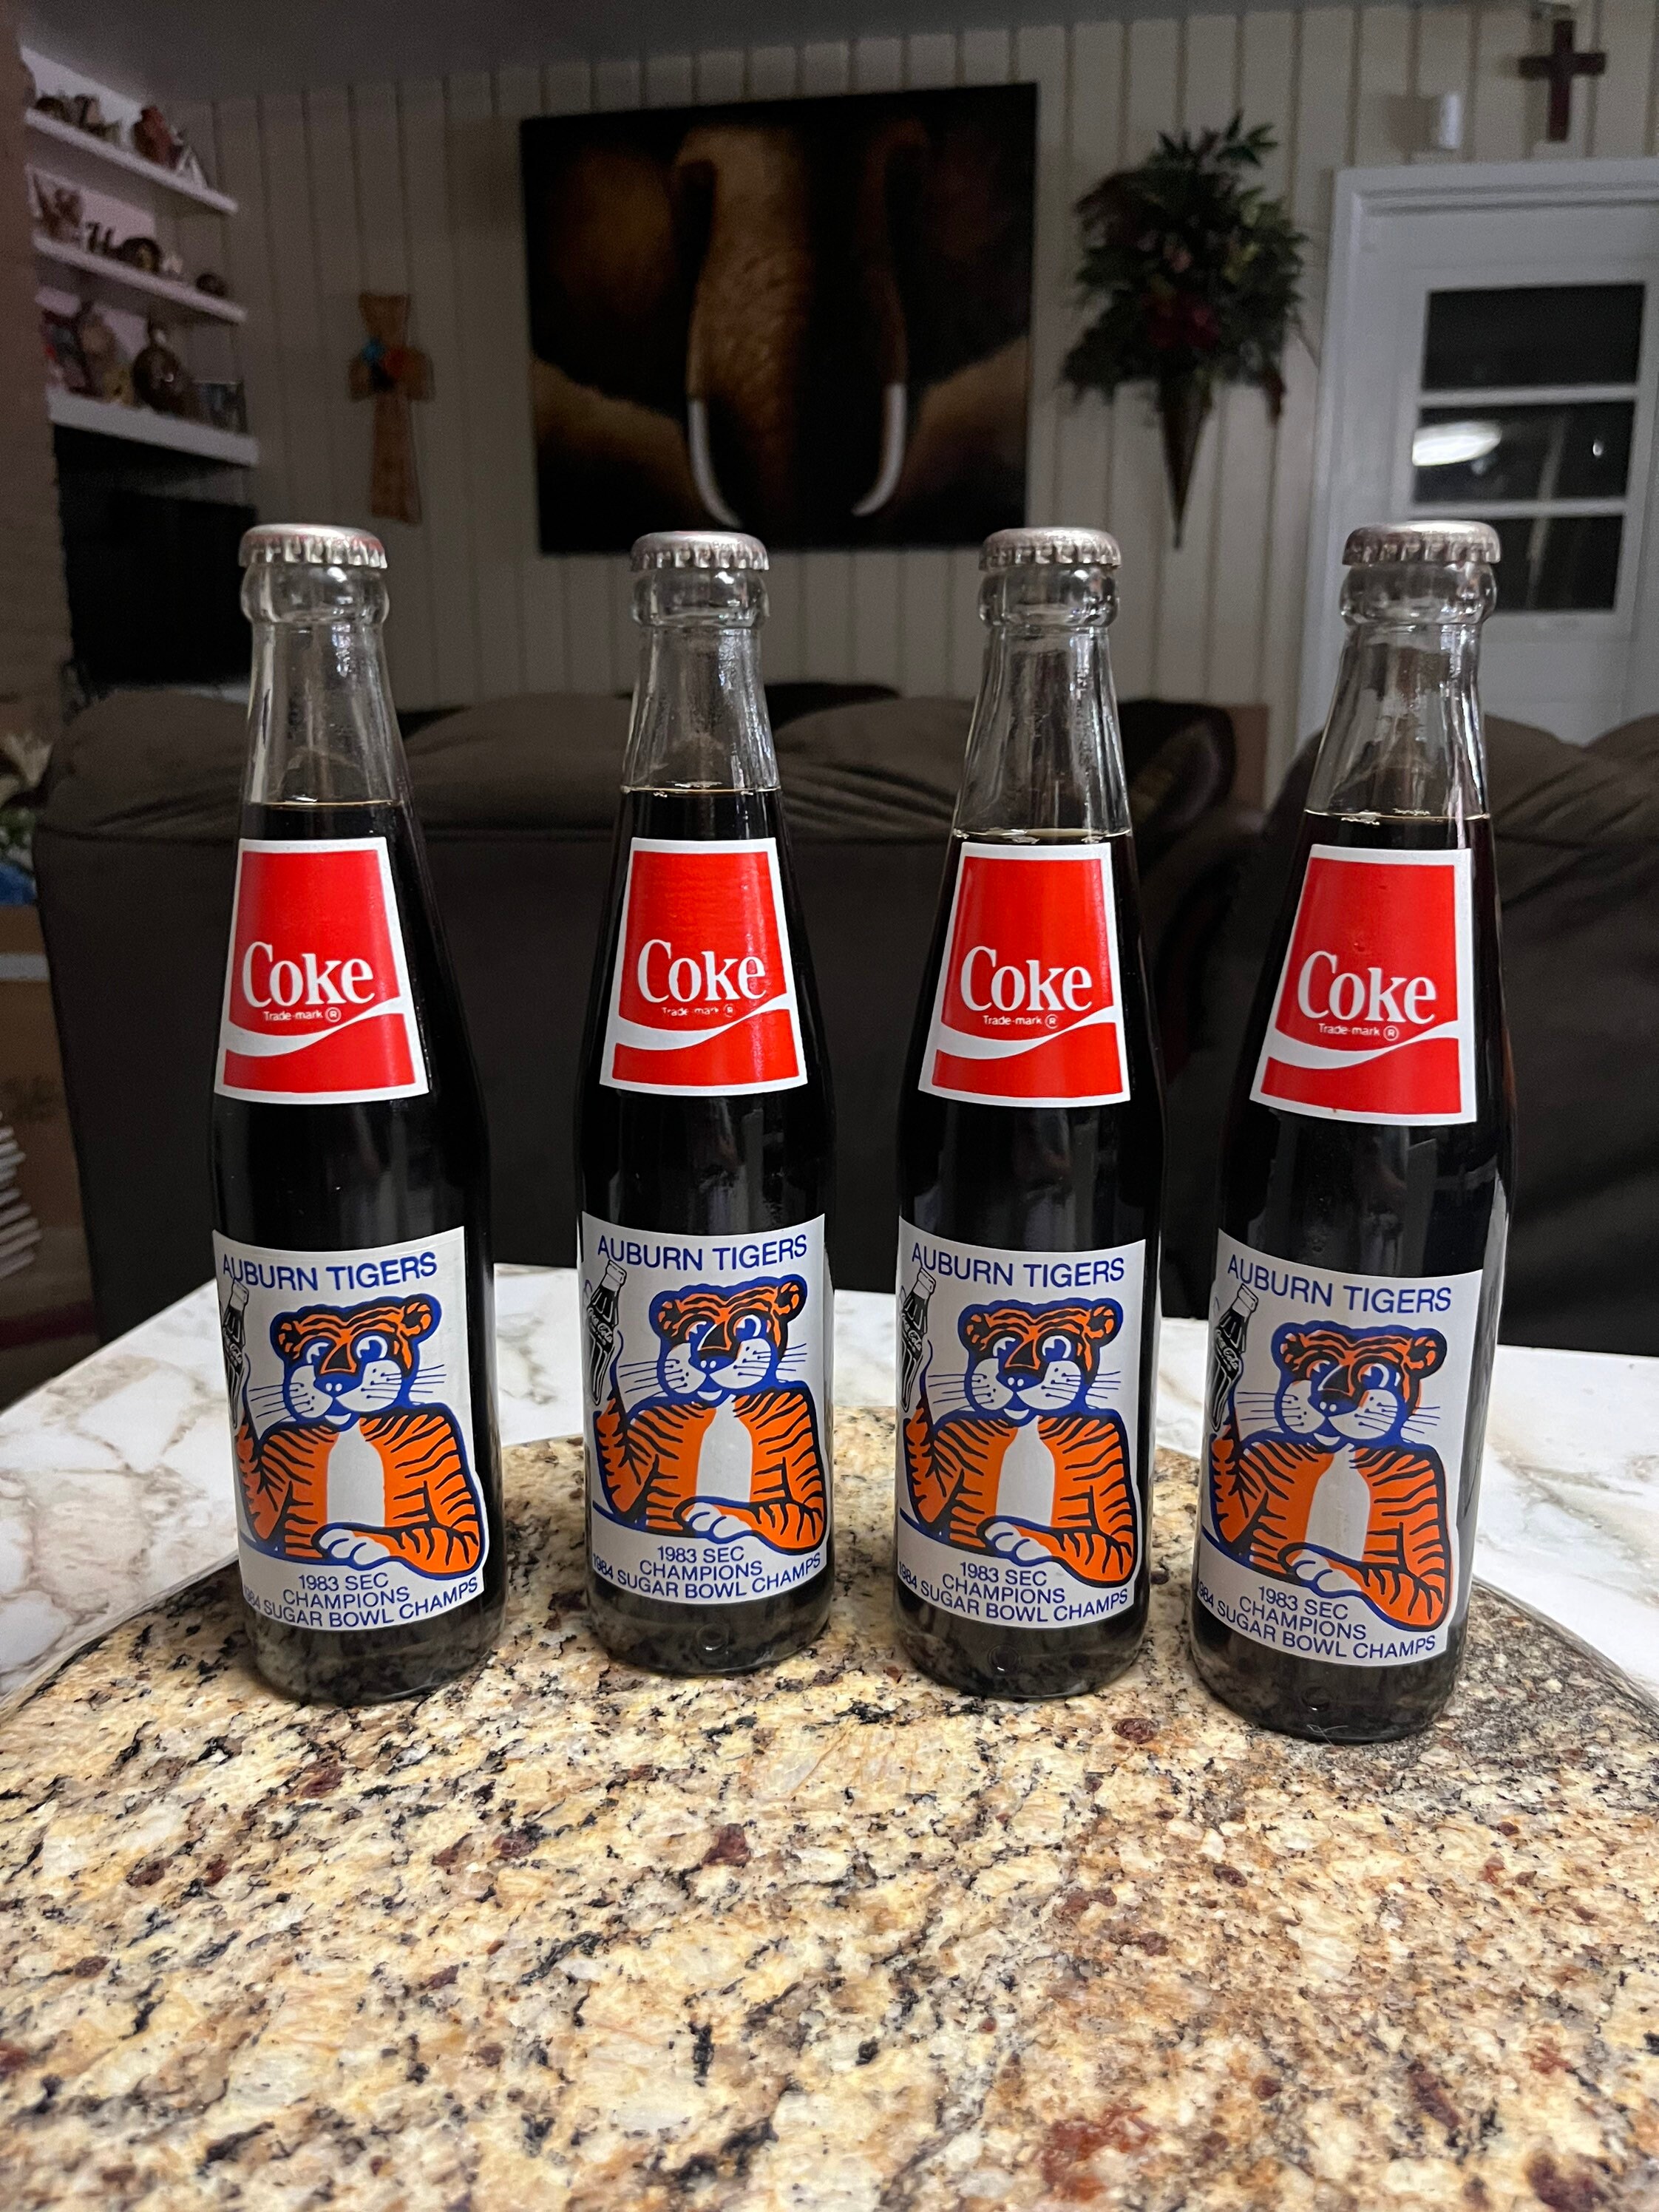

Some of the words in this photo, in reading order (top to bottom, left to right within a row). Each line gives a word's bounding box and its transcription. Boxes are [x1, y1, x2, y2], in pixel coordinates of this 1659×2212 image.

[242, 941, 376, 1008] Coke
[637, 939, 767, 1003] Coke
[960, 946, 1093, 1011] Coke
[1297, 950, 1436, 1025] Coke
[223, 1254, 319, 1291] AUBURN
[326, 1251, 438, 1291] TIGERS
[597, 1235, 703, 1271] AUBURN
[712, 1234, 807, 1271] TIGERS
[912, 1242, 1013, 1286] AUBURN
[1023, 1257, 1125, 1288] TIGERS
[1227, 1254, 1333, 1307] AUBURN
[1343, 1284, 1452, 1314] TIGERS
[617, 1569, 679, 1598] SUGAR
[685, 1581, 747, 1599] BOWL
[751, 1552, 821, 1593] CHAMPS
[639, 1559, 763, 1581] CHAMPIONS
[657, 1545, 697, 1564] 1983
[703, 1546, 744, 1564] SEC
[960, 1561, 1000, 1583] 1983
[1005, 1569, 1047, 1587] SEC
[265, 1600, 322, 1627] SUGAR
[329, 1609, 395, 1627] BOWL
[399, 1576, 478, 1620] CHAMPS
[283, 1586, 410, 1609] CHAMPIONS
[299, 1574, 339, 1591] 1983
[345, 1573, 389, 1590] SEC
[920, 1581, 980, 1616] SUGAR
[985, 1602, 1048, 1622] BOWL
[1054, 1588, 1128, 1621] CHAMPS
[943, 1573, 1065, 1604] CHAMPIONS
[1258, 1586, 1298, 1611] 1983
[1303, 1598, 1348, 1620] SEC
[1198, 1581, 1214, 1608] 984
[1218, 1601, 1277, 1642] SUGAR
[1283, 1632, 1347, 1658] BOWL
[1352, 1635, 1436, 1659] CHAMPS
[1239, 1595, 1366, 1641] CHAMPIONS
